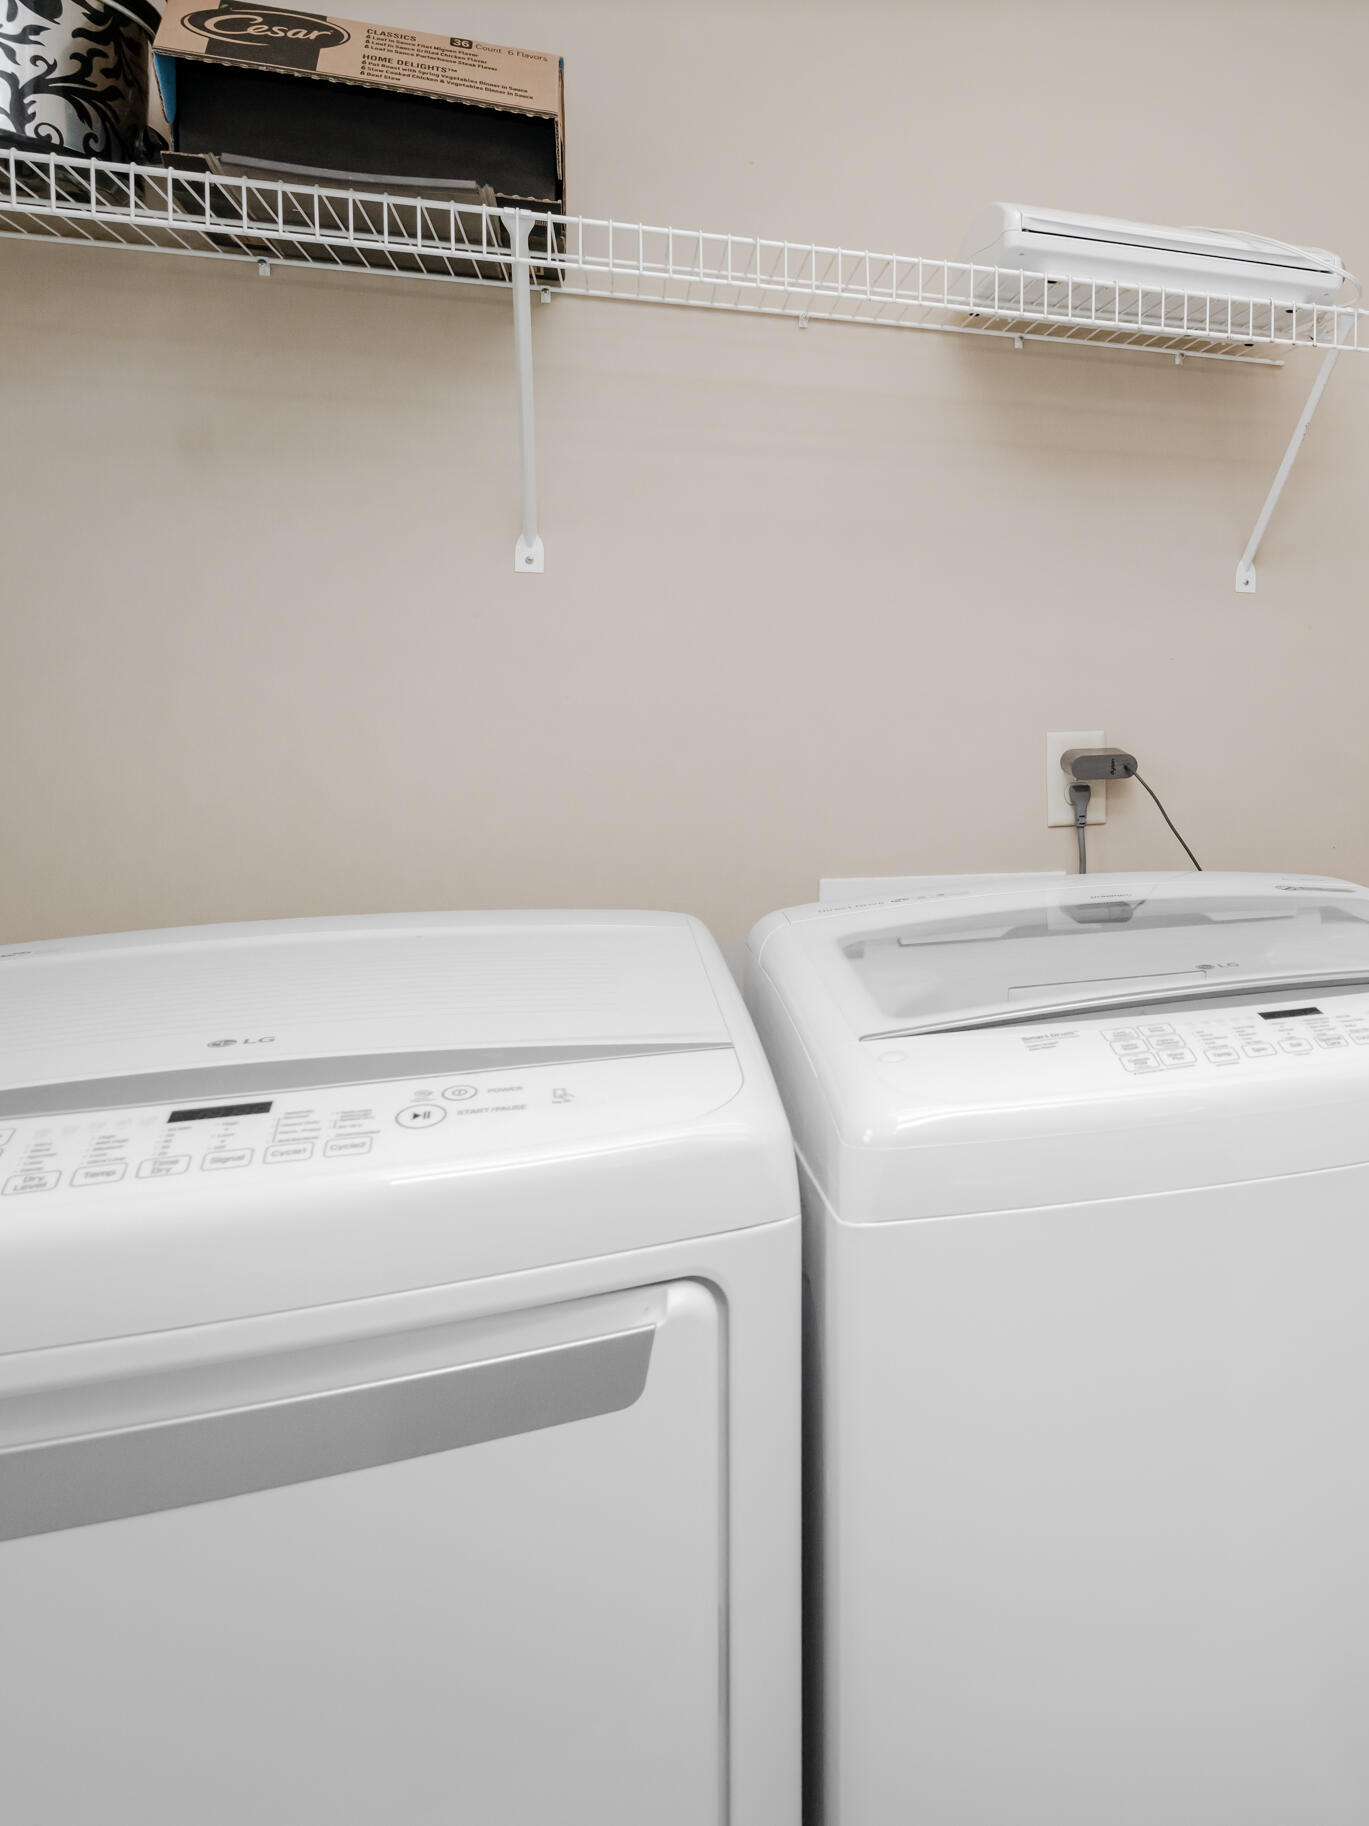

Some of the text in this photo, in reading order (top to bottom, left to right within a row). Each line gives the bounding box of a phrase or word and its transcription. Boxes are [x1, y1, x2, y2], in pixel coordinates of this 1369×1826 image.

[204, 15, 332, 40] Cesar
[367, 29, 416, 41] CLASSICS
[441, 52, 465, 60] Chicken
[453, 39, 470, 48] 36
[476, 44, 501, 53] Count
[517, 51, 548, 61] Flavors
[363, 54, 393, 63] HOME
[416, 54, 456, 64] Porterhouse
[412, 74, 438, 82] Chicken
[447, 81, 483, 90] Vegetables
[418, 70, 439, 78] Spring
[441, 74, 477, 84] Vegetables
